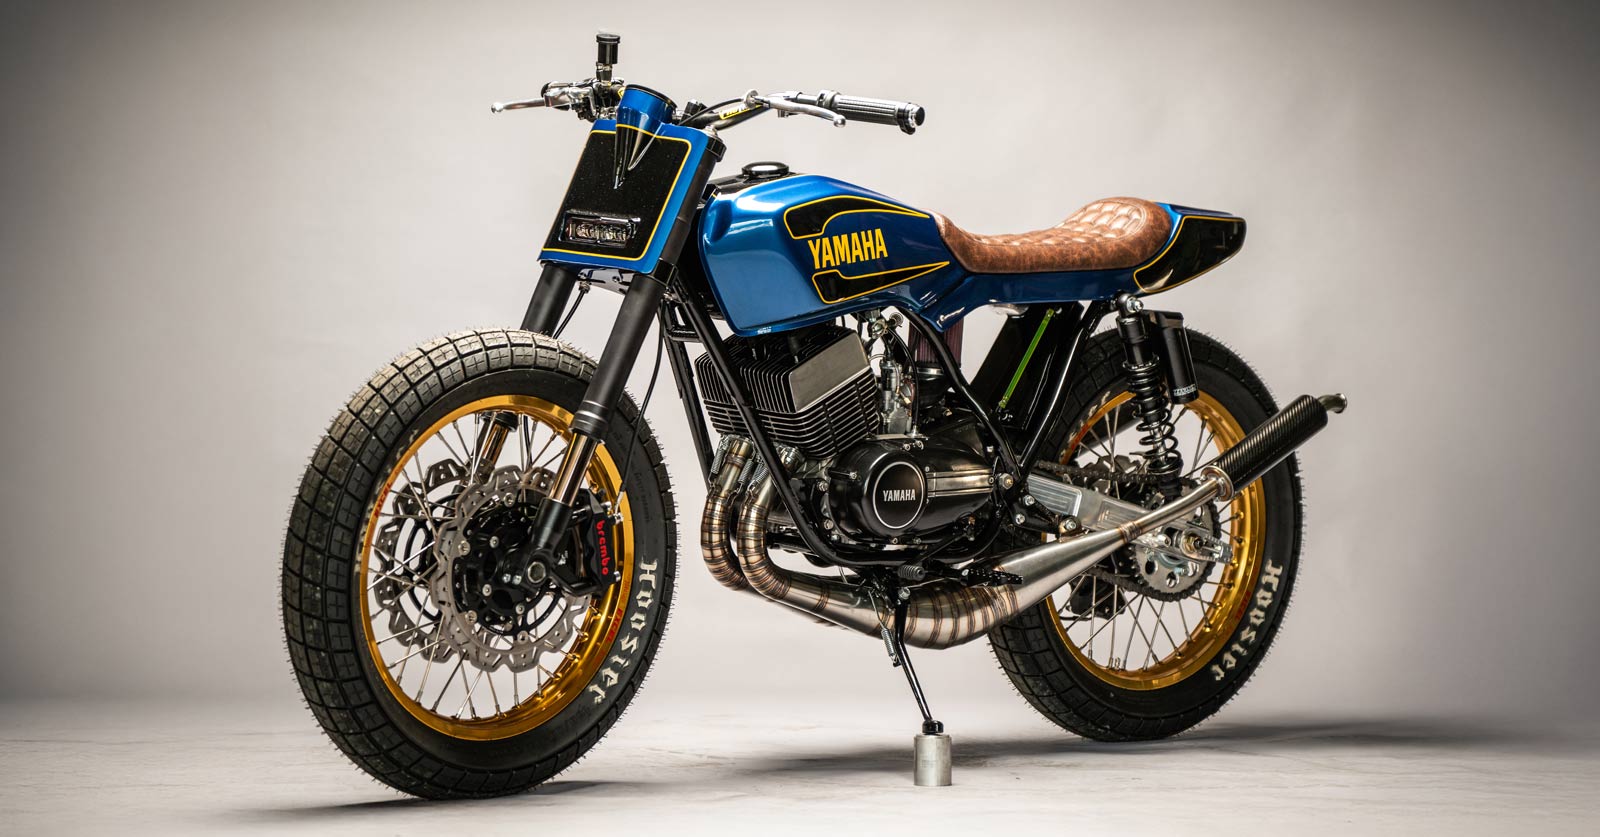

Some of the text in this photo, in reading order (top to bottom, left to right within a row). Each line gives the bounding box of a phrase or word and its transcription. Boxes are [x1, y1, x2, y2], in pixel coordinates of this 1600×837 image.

[808, 228, 888, 269] YAMAHA
[883, 489, 916, 501] YAMAHA
[595, 519, 609, 576] brembo
[588, 556, 658, 704] Hoosier
[1211, 559, 1283, 681] Hoosier
